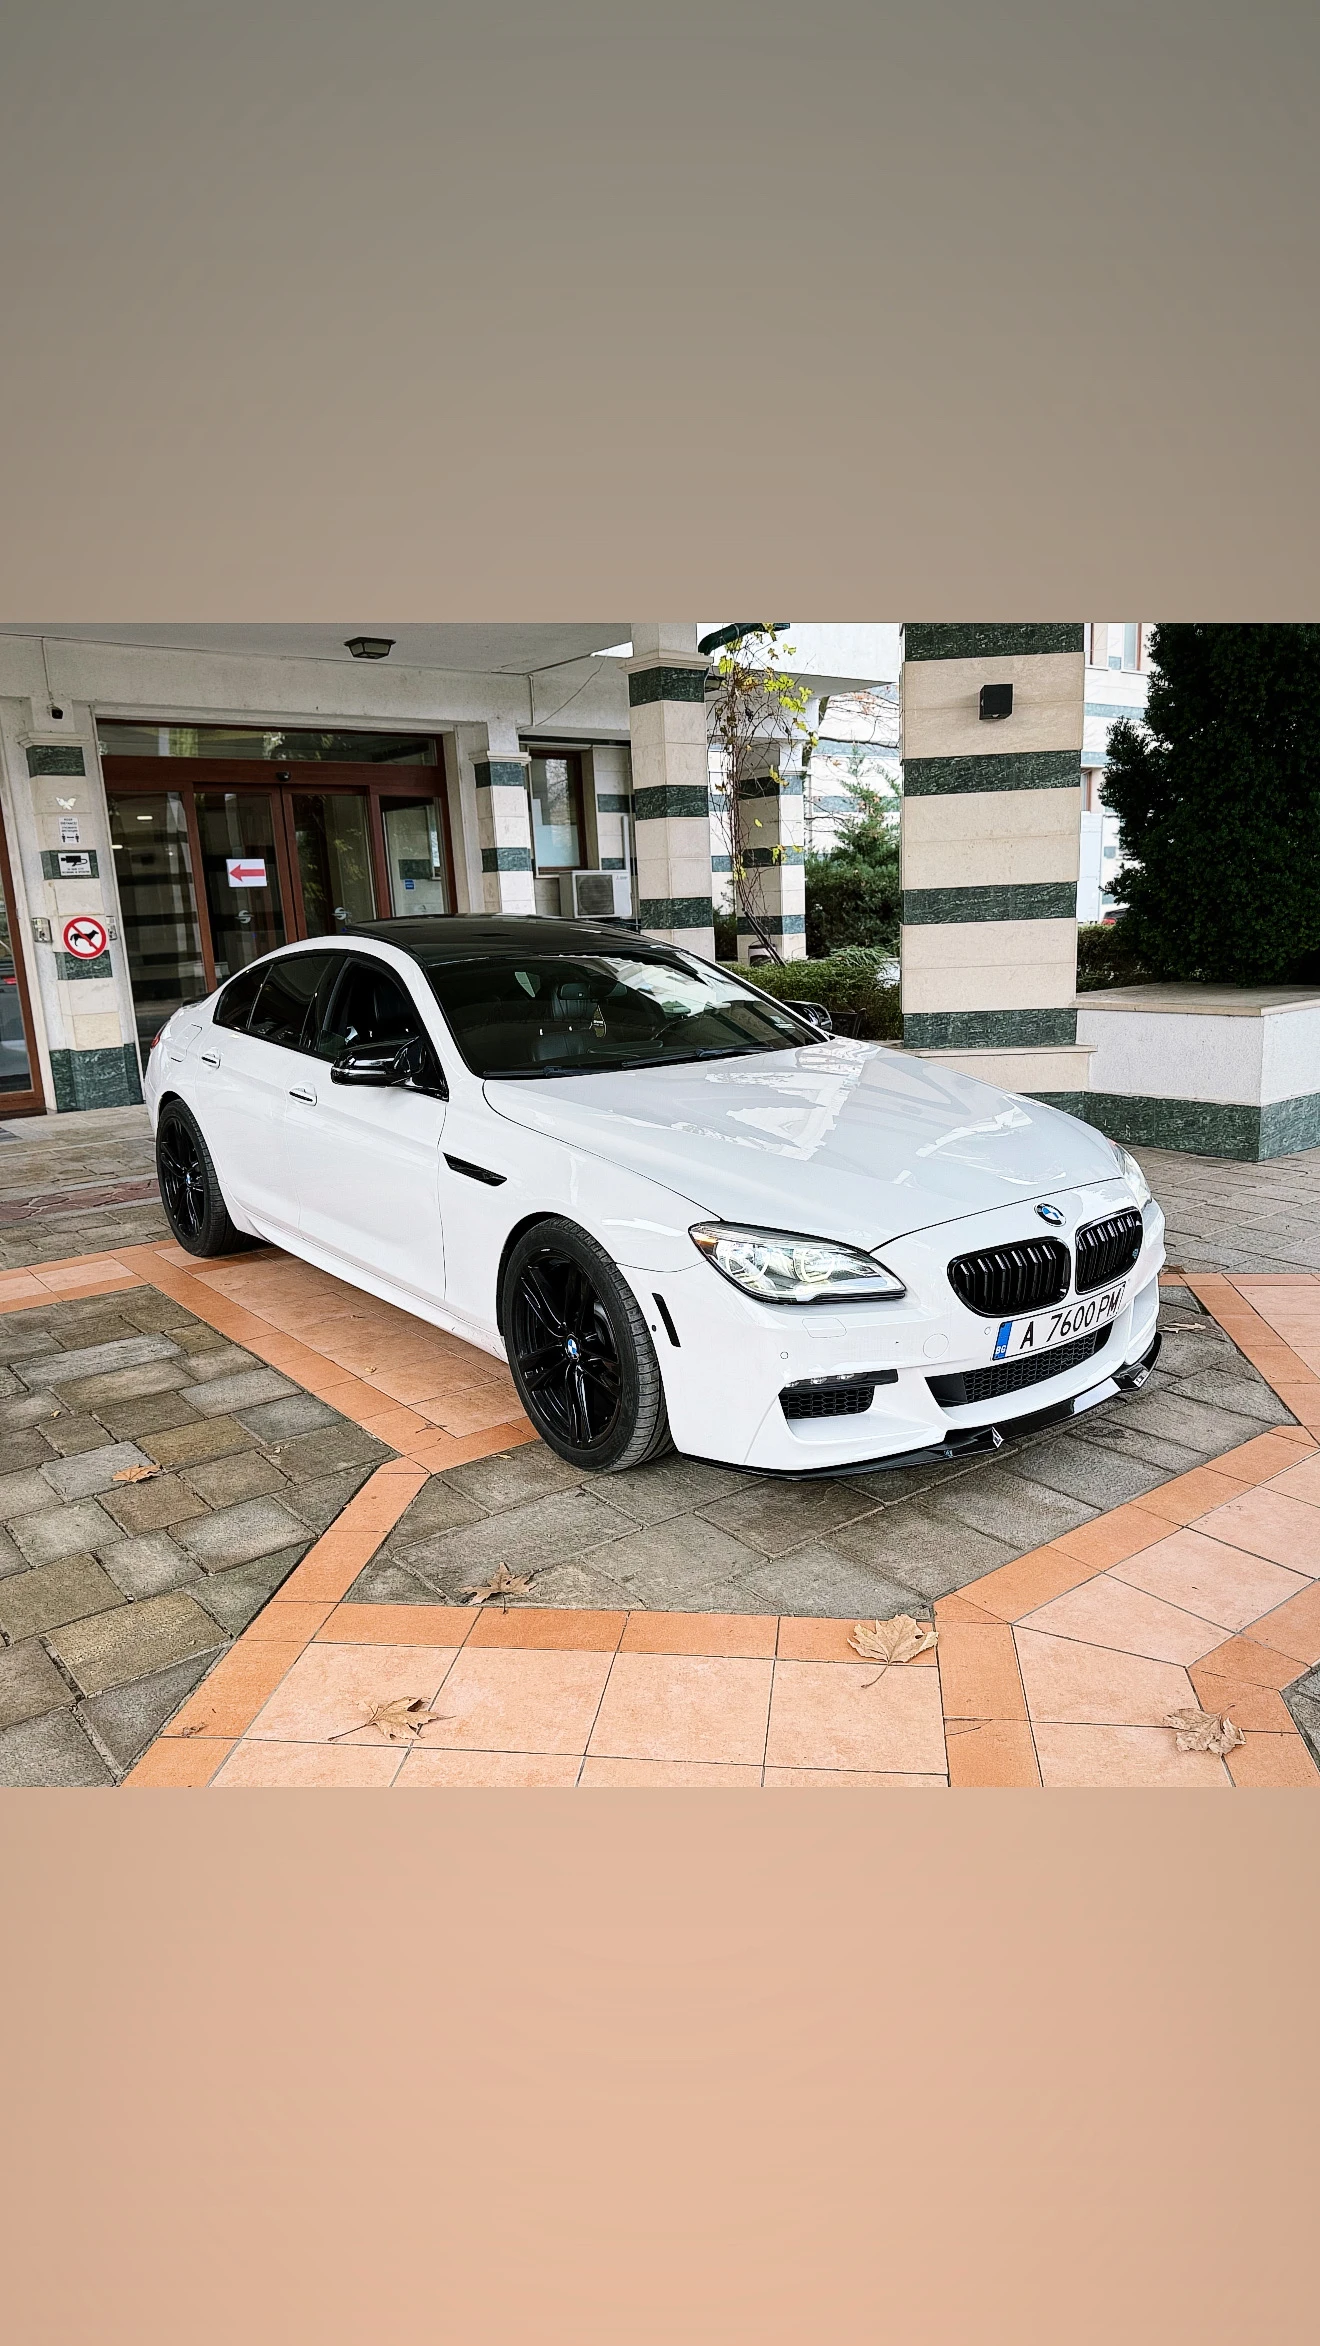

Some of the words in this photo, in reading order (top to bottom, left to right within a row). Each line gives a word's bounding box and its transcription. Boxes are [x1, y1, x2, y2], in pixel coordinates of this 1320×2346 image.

[1020, 1321, 1034, 1349] A
[1046, 1301, 1096, 1342] 7600
[995, 1345, 1007, 1354] BG
